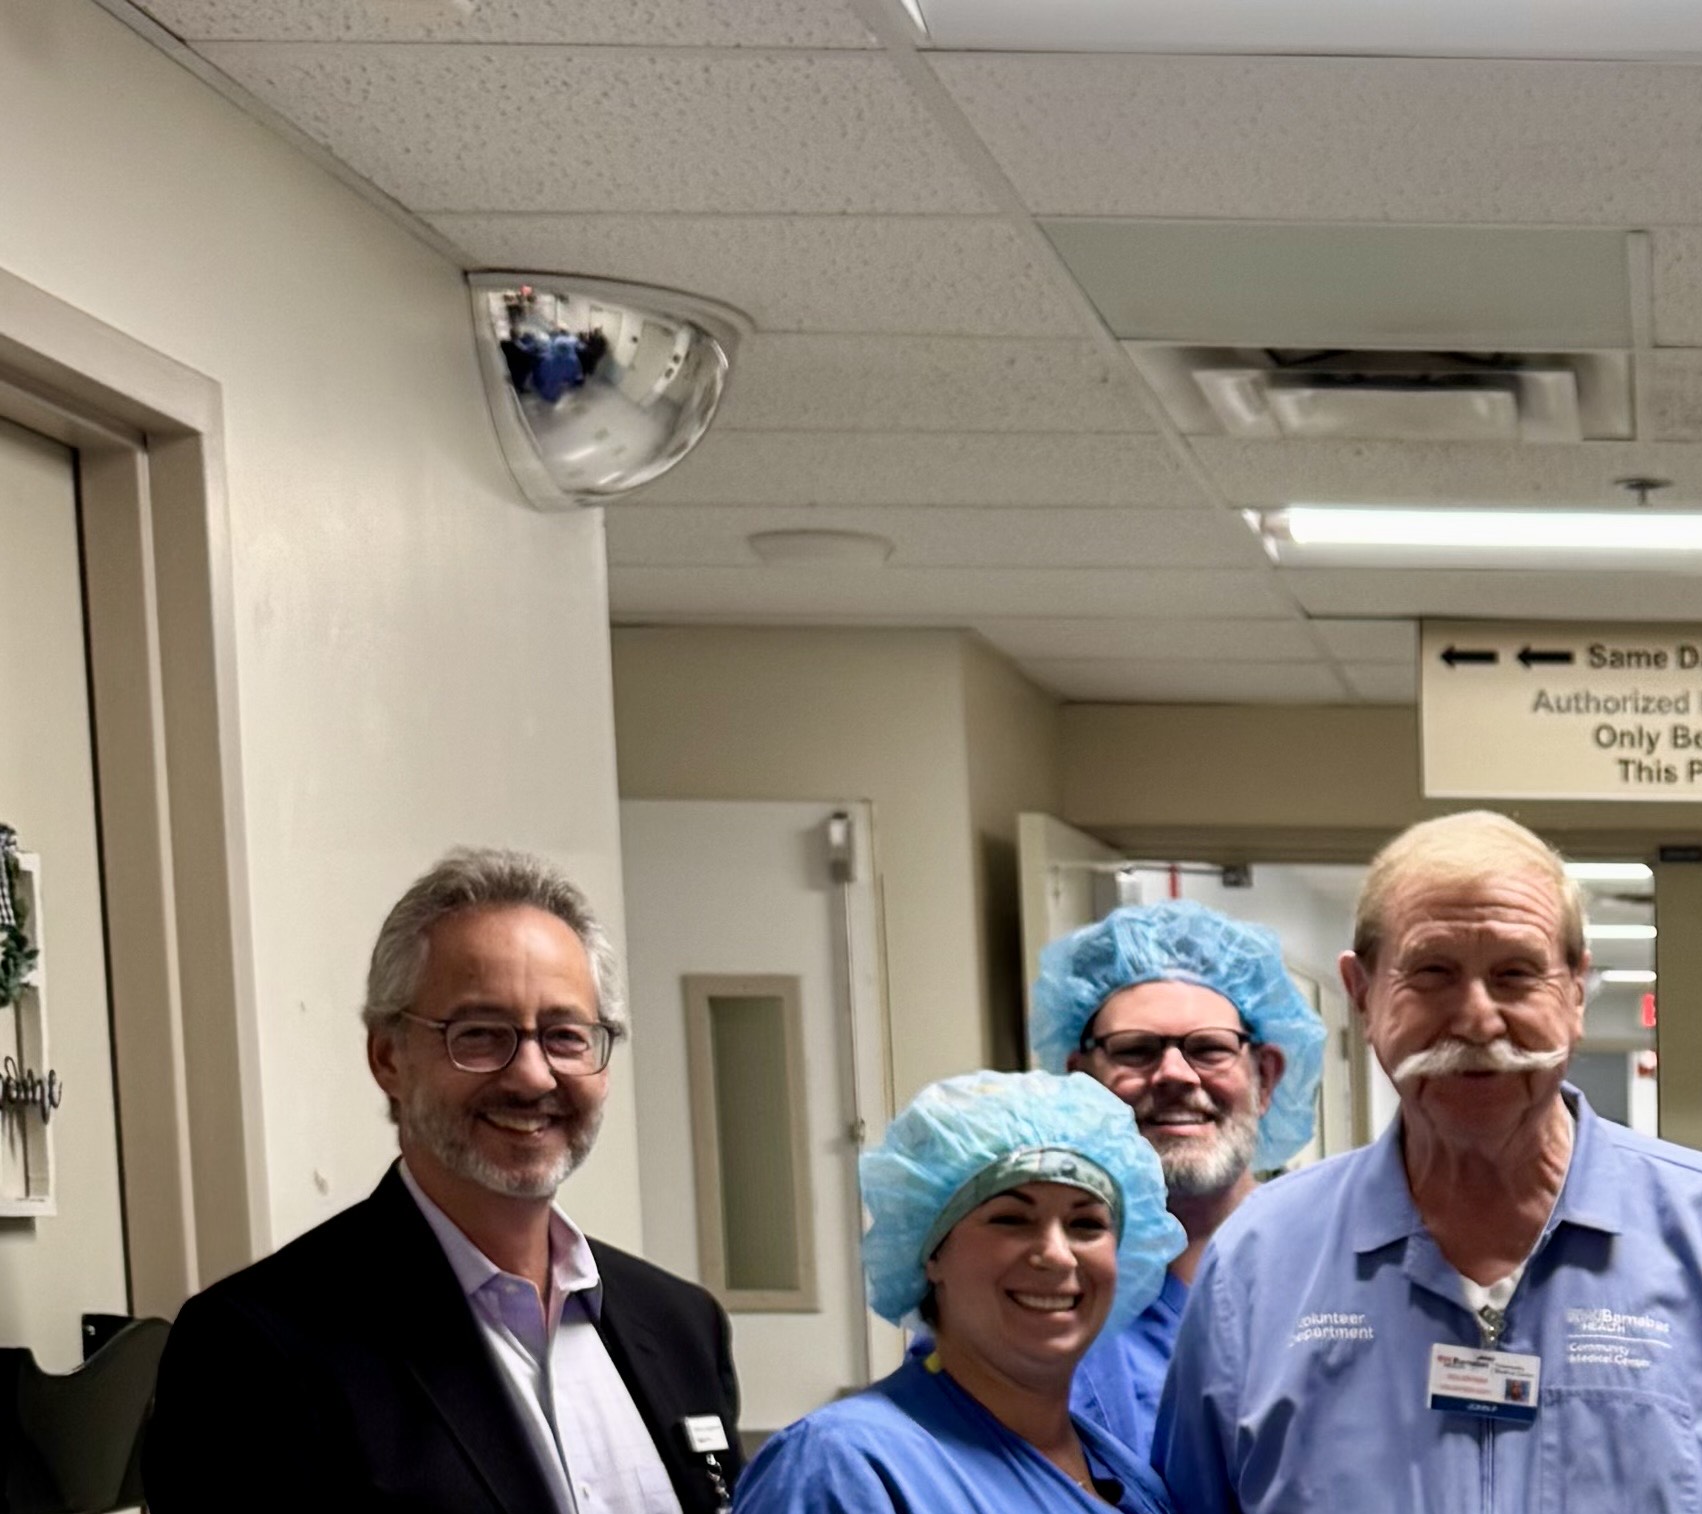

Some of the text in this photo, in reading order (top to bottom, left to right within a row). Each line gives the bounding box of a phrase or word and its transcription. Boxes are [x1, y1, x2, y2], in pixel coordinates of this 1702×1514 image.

[1588, 644, 1669, 669] Same
[1532, 690, 1690, 715] Authorized
[1594, 724, 1661, 754] Only
[1617, 758, 1678, 784] This
[1298, 1312, 1366, 1328] olunteer
